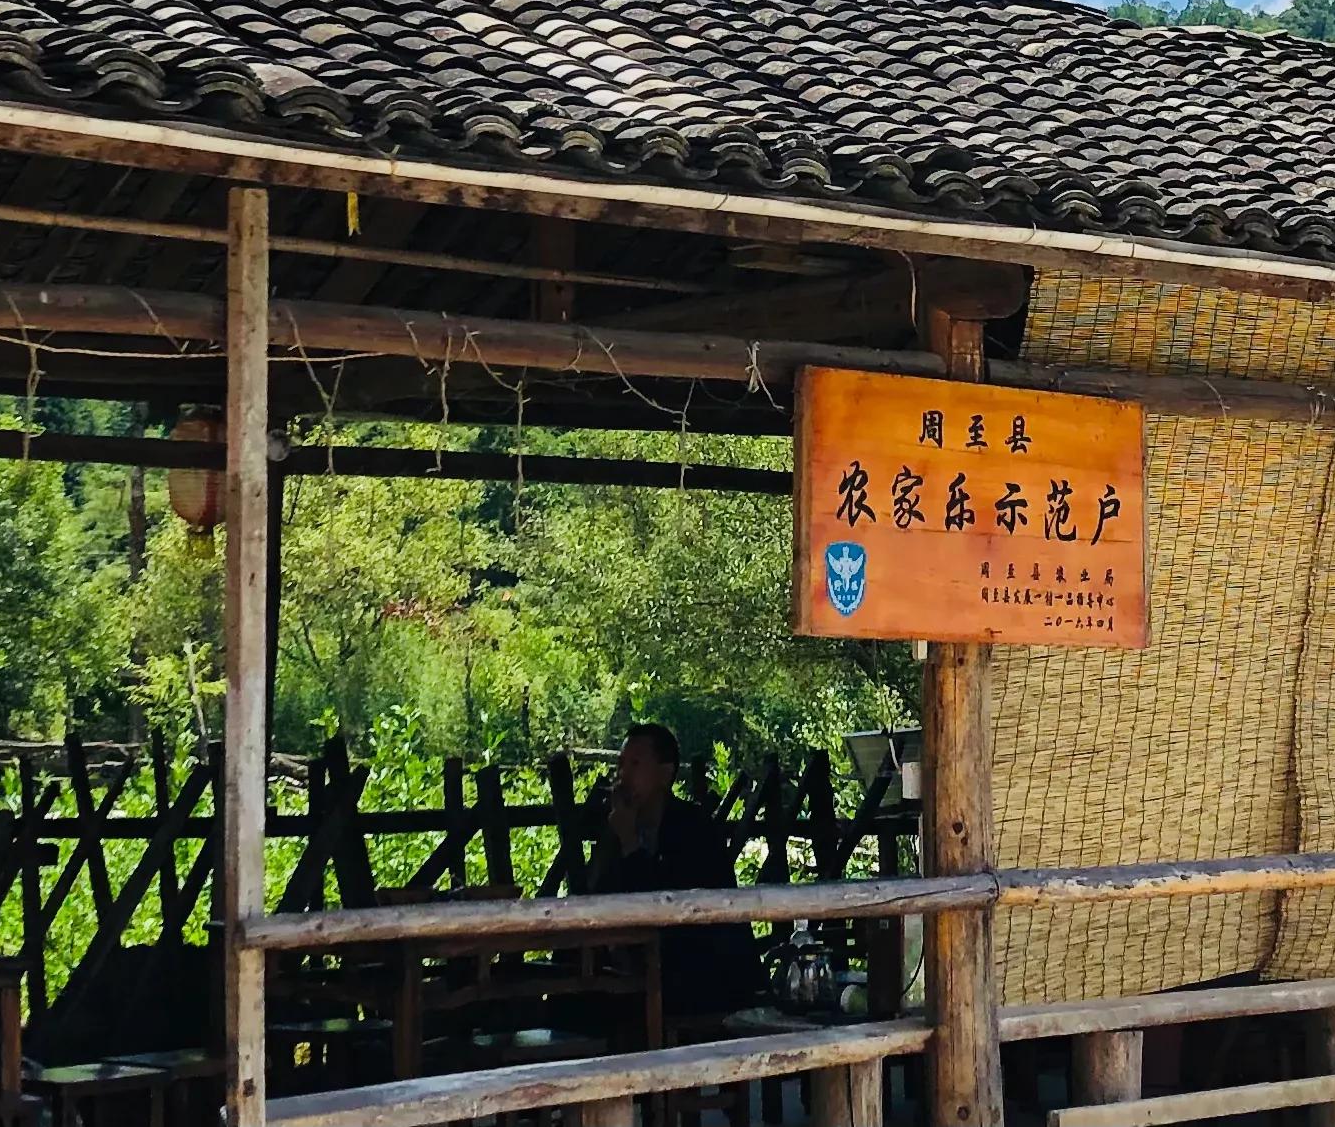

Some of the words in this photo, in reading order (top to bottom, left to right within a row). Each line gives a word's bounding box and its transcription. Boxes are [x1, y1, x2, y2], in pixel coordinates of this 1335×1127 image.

[919, 410, 1032, 453] 周至县
[836, 461, 1121, 546] 农家乐示范户
